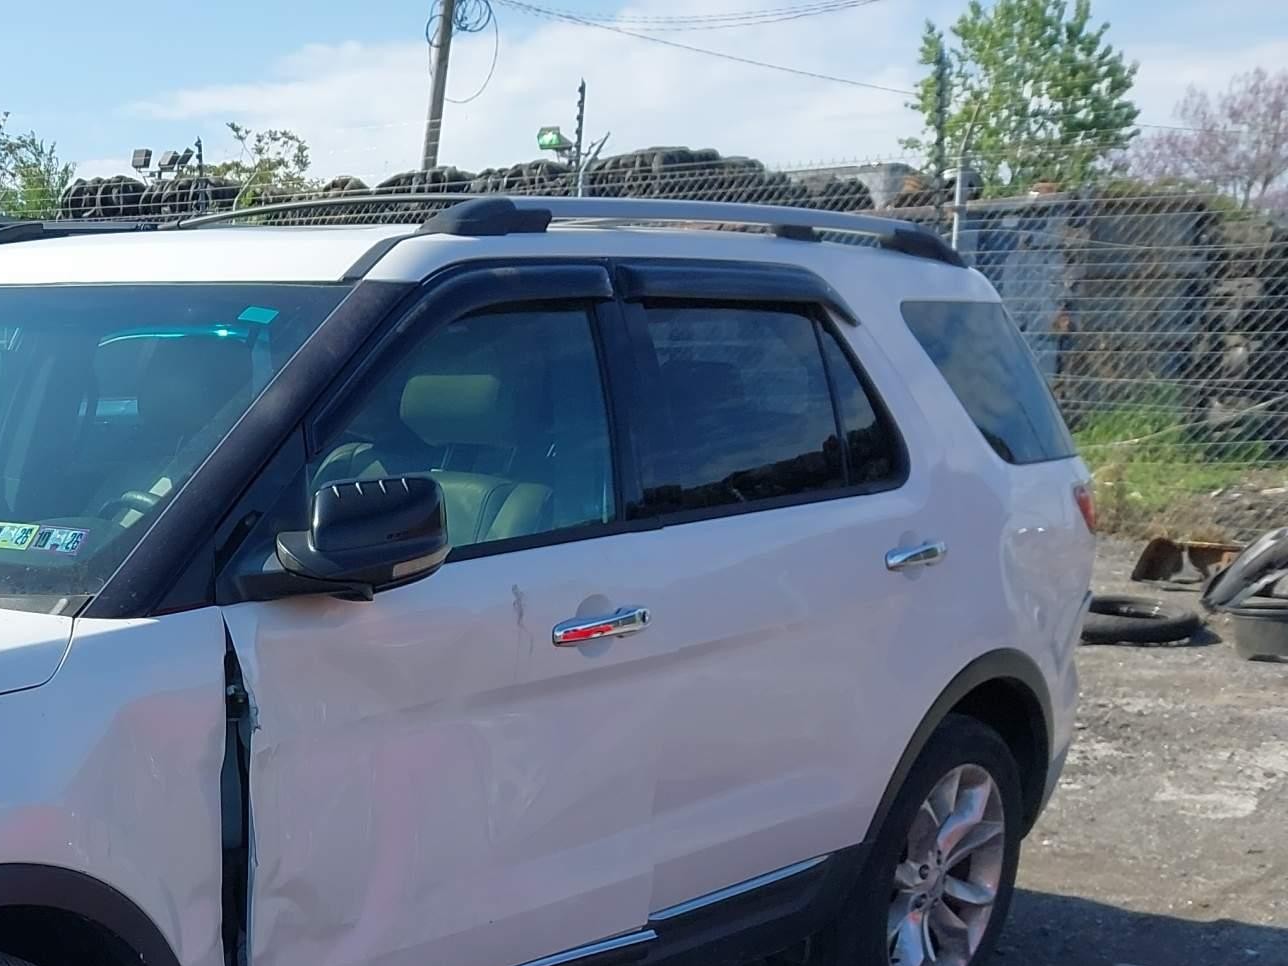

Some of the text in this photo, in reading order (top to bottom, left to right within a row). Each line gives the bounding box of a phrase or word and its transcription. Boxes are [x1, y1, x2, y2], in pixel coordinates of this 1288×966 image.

[14, 528, 35, 545] 26
[34, 531, 83, 550] 10 26
